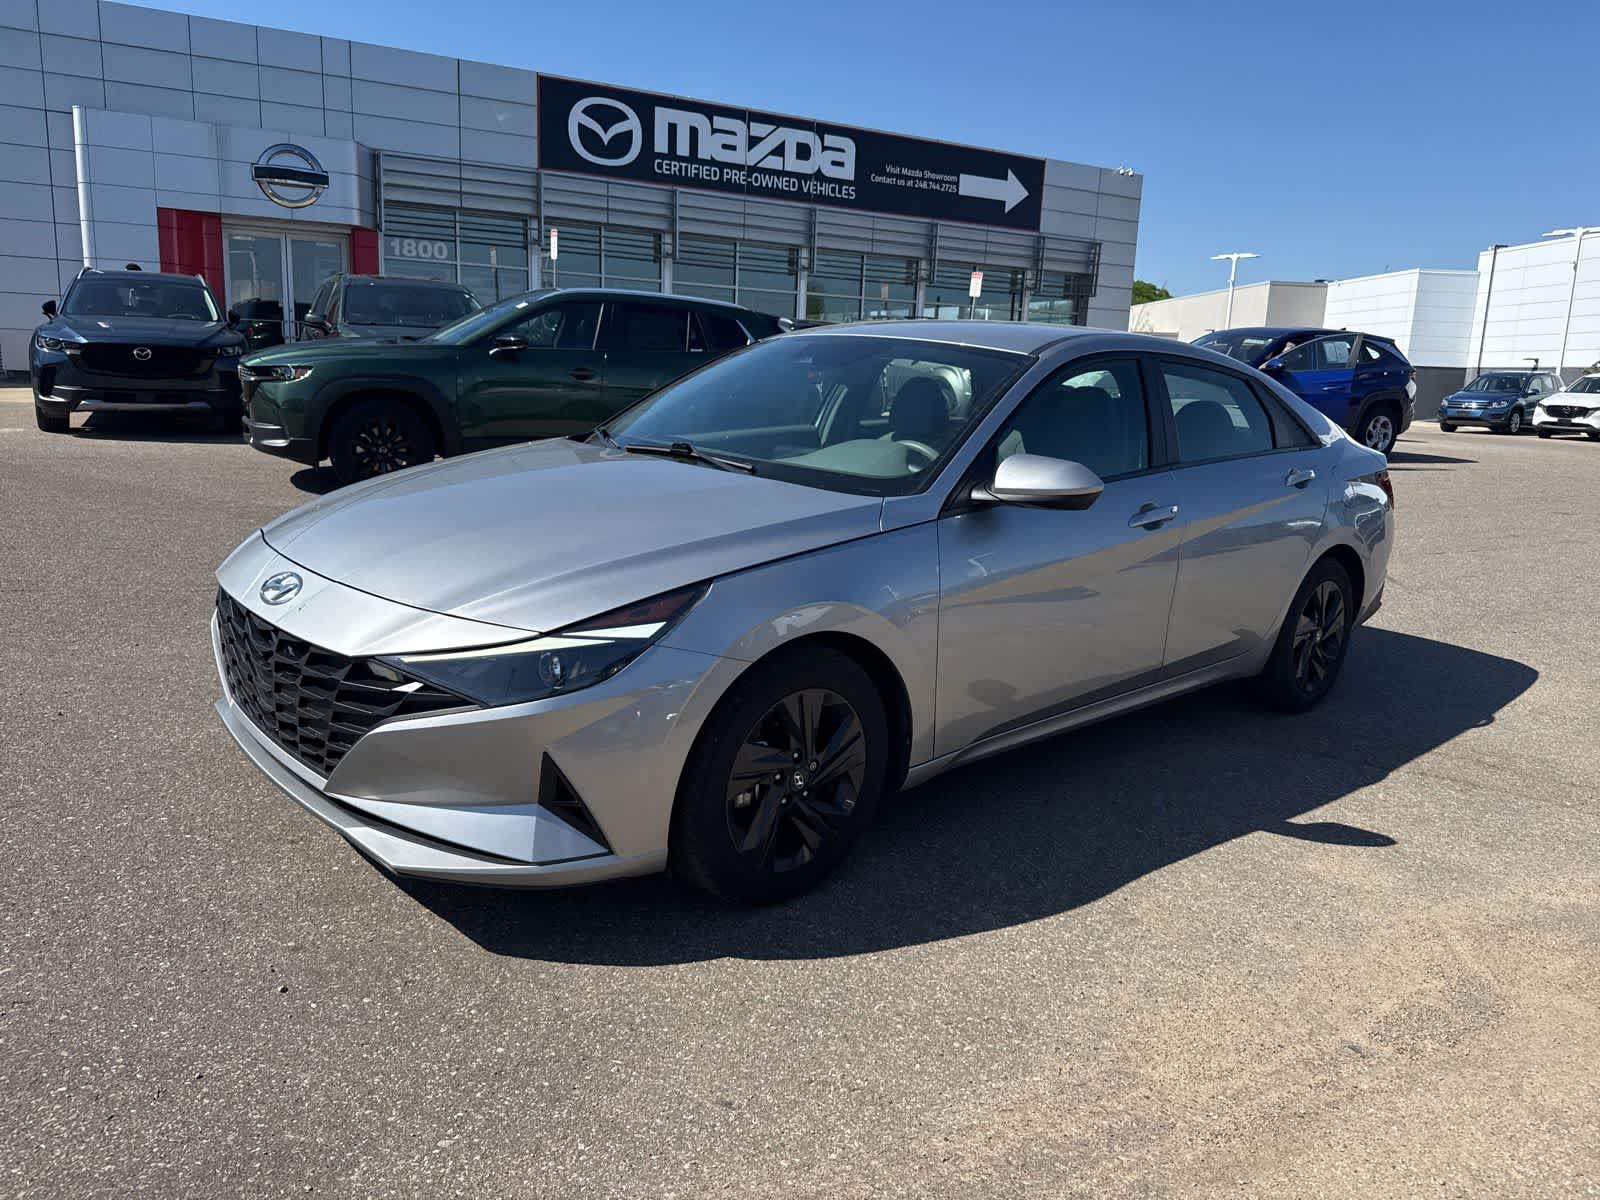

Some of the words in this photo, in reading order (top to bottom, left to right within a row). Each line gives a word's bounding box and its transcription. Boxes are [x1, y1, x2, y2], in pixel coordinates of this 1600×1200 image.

[654, 159, 720, 181] CERTIFIED
[723, 168, 798, 192] PRE-OWNED
[801, 178, 856, 200] VEHICLES
[870, 173, 896, 185] Contact
[885, 163, 900, 174] Visit
[901, 167, 922, 178] Mazda
[924, 170, 958, 182] Showroom
[390, 238, 448, 259] 1800
